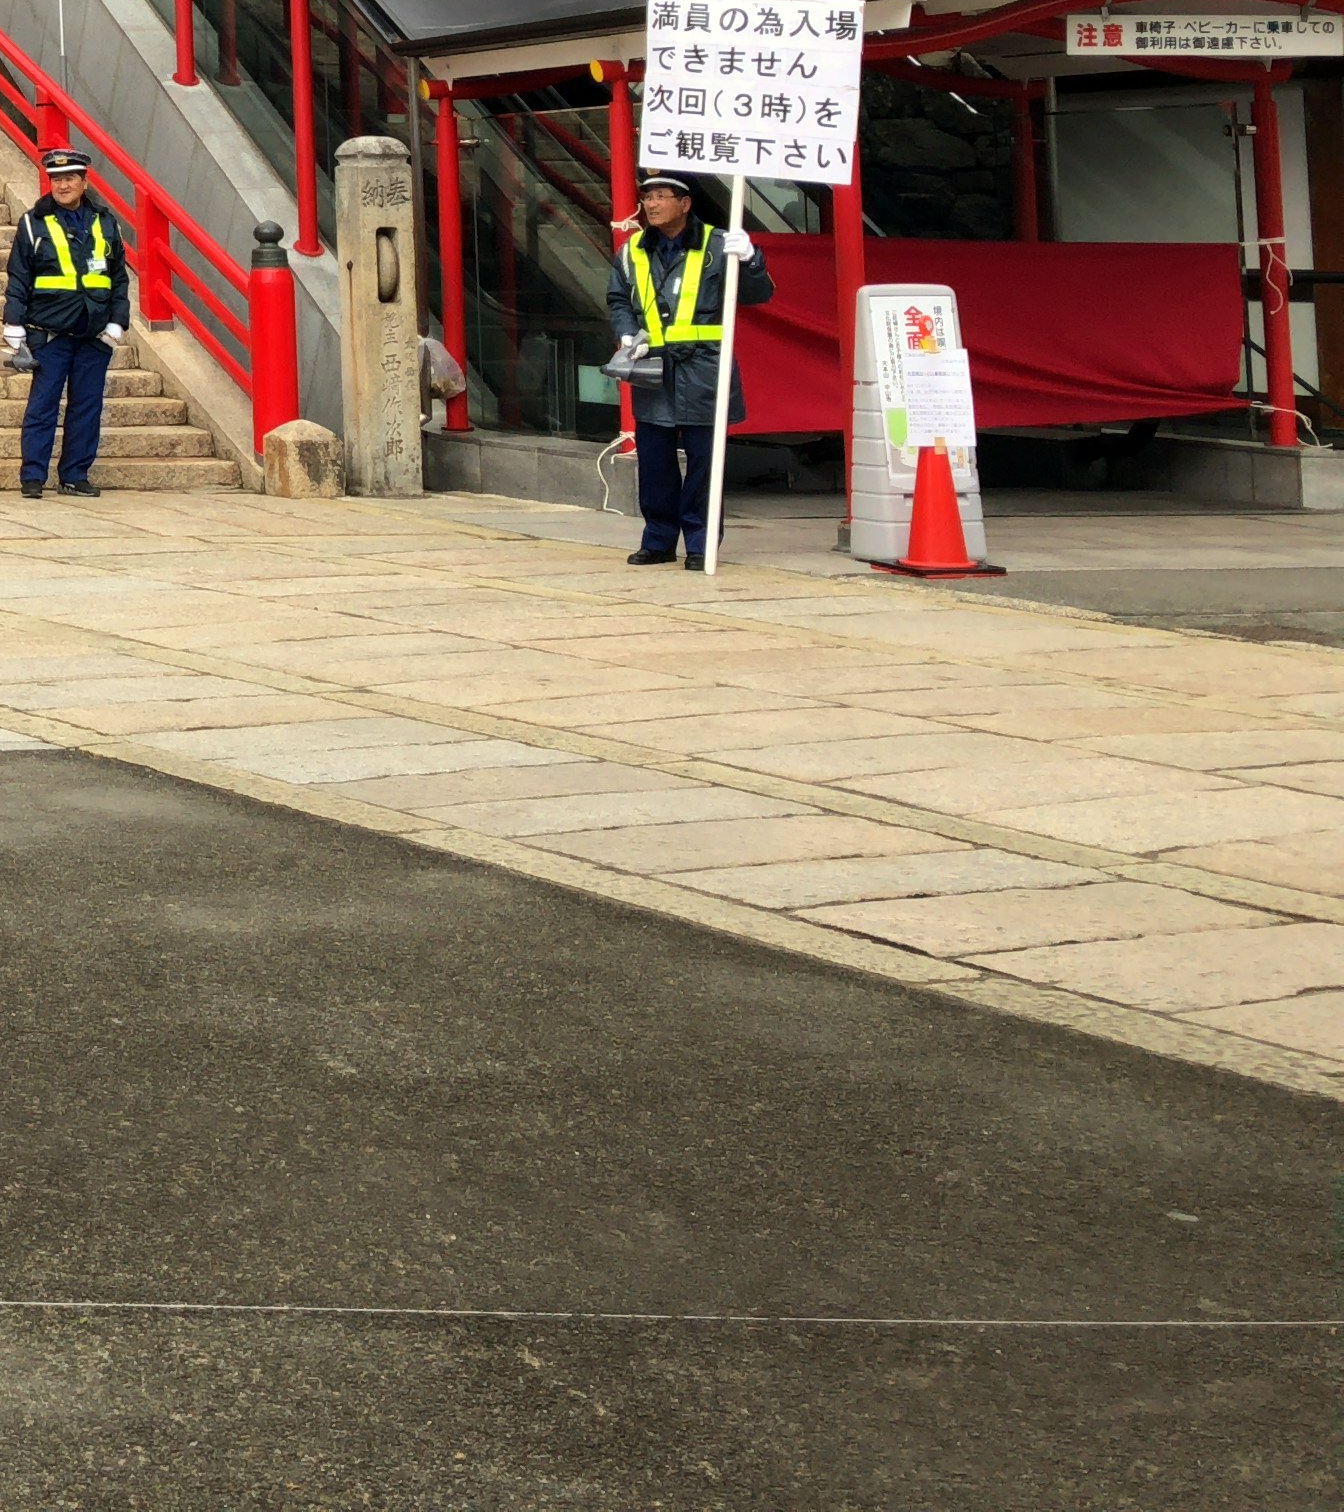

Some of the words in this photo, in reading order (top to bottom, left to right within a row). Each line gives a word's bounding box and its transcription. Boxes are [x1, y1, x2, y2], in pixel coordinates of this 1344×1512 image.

[652, 0, 858, 41] 満員の為入場
[1077, 23, 1124, 48] 注意
[1135, 36, 1284, 50] 御利用は御遠慮下さい。
[651, 44, 818, 80] できません
[647, 85, 843, 128] 次回(3時)を
[647, 129, 848, 170] ご観覧下さい
[361, 176, 411, 212] 奉納
